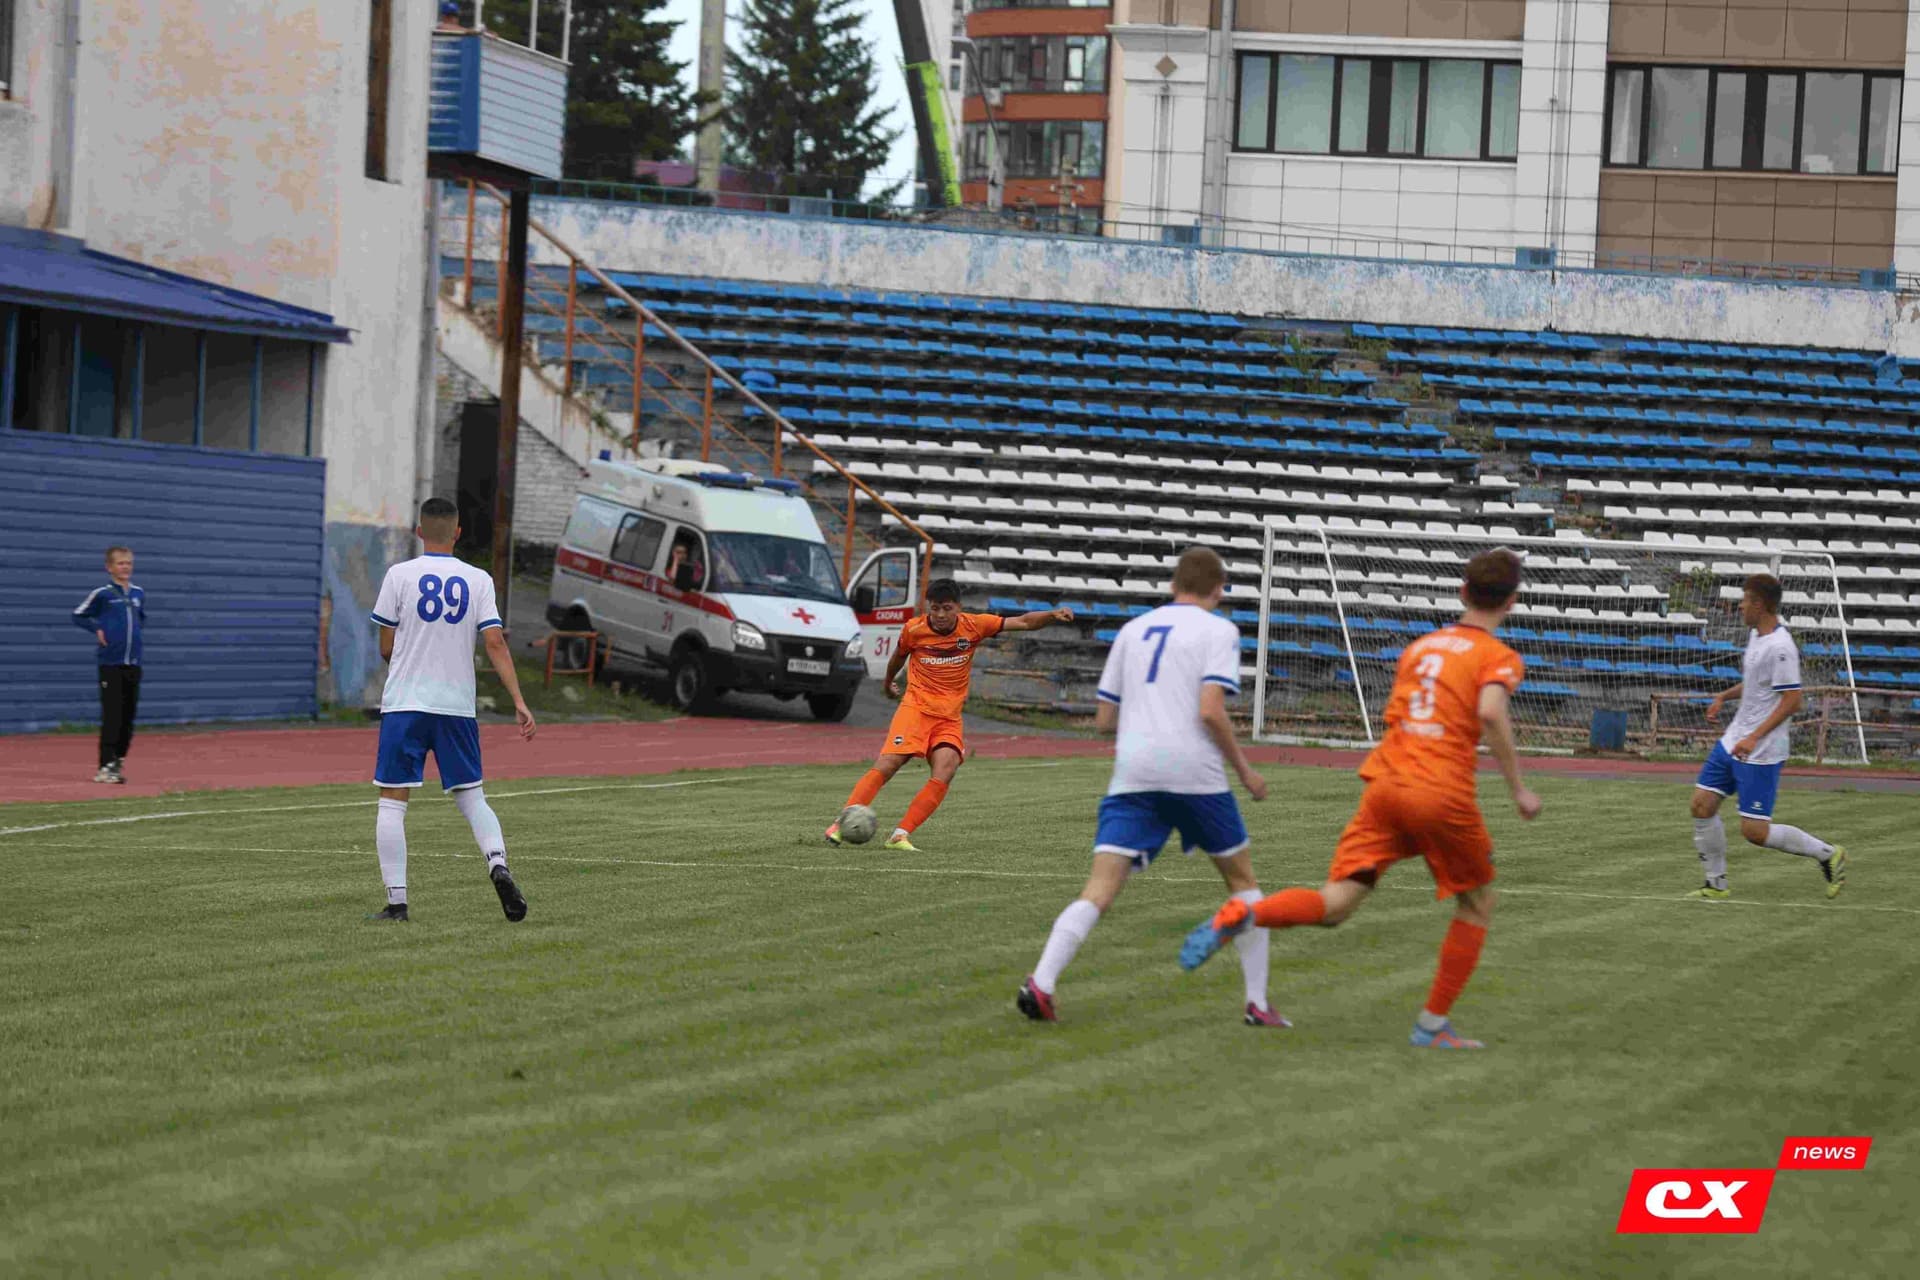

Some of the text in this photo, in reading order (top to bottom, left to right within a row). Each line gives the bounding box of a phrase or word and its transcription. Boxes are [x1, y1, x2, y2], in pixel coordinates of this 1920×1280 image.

[417, 574, 469, 624] 89
[875, 636, 891, 656] 31
[1142, 625, 1174, 683] 7
[1408, 654, 1444, 720] 3
